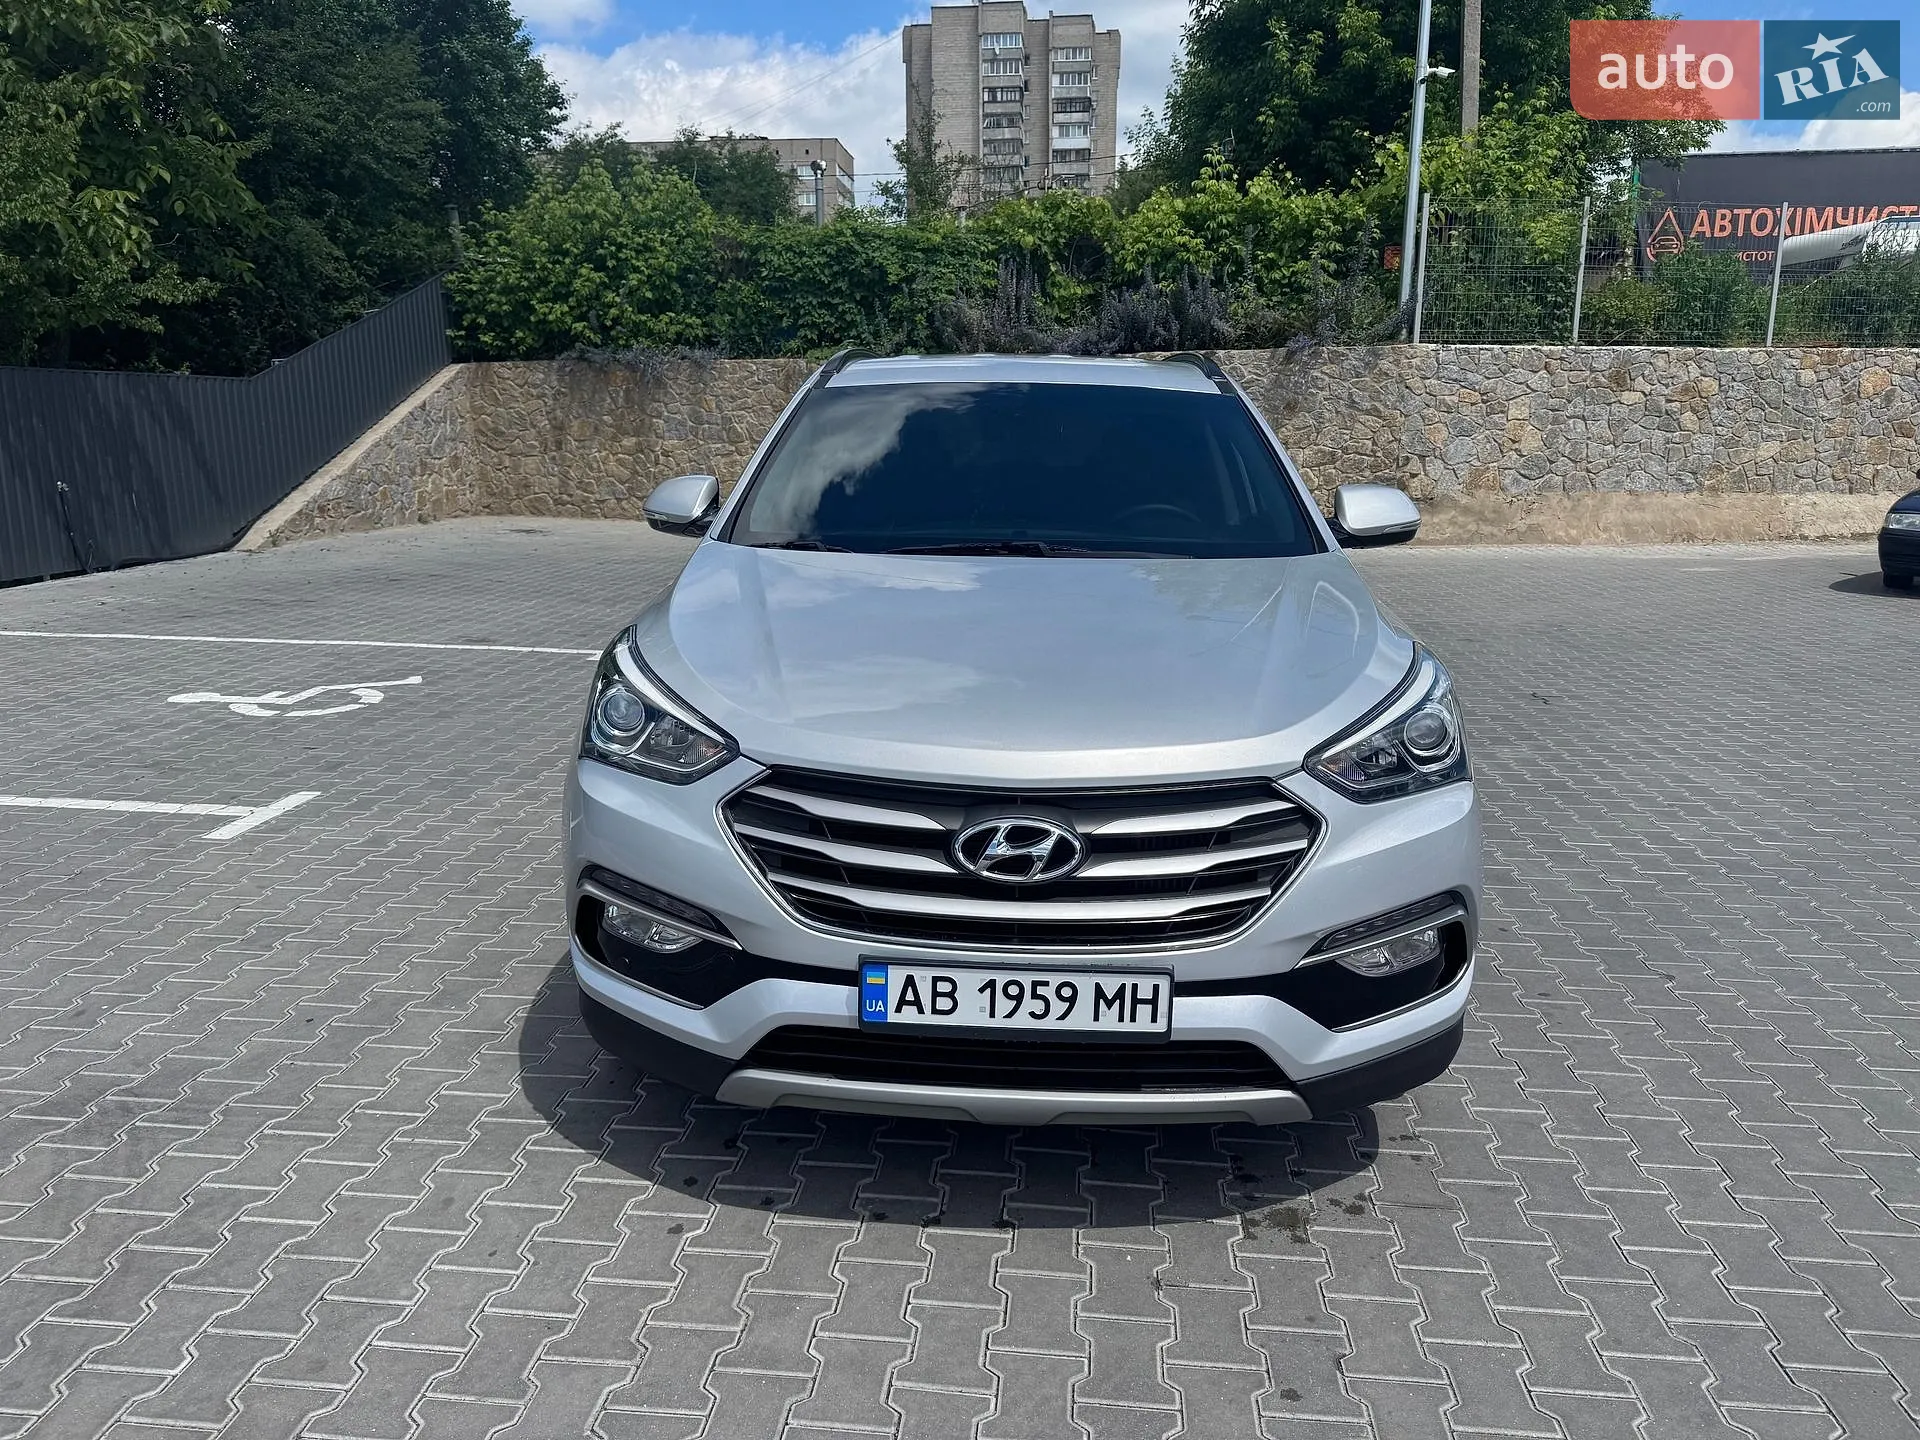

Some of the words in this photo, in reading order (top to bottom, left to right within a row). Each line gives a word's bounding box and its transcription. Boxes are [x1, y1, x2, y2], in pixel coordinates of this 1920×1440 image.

[866, 999, 886, 1013] UA
[894, 974, 959, 1016] AB
[977, 978, 1079, 1021] 1959
[1093, 981, 1160, 1023] MH
